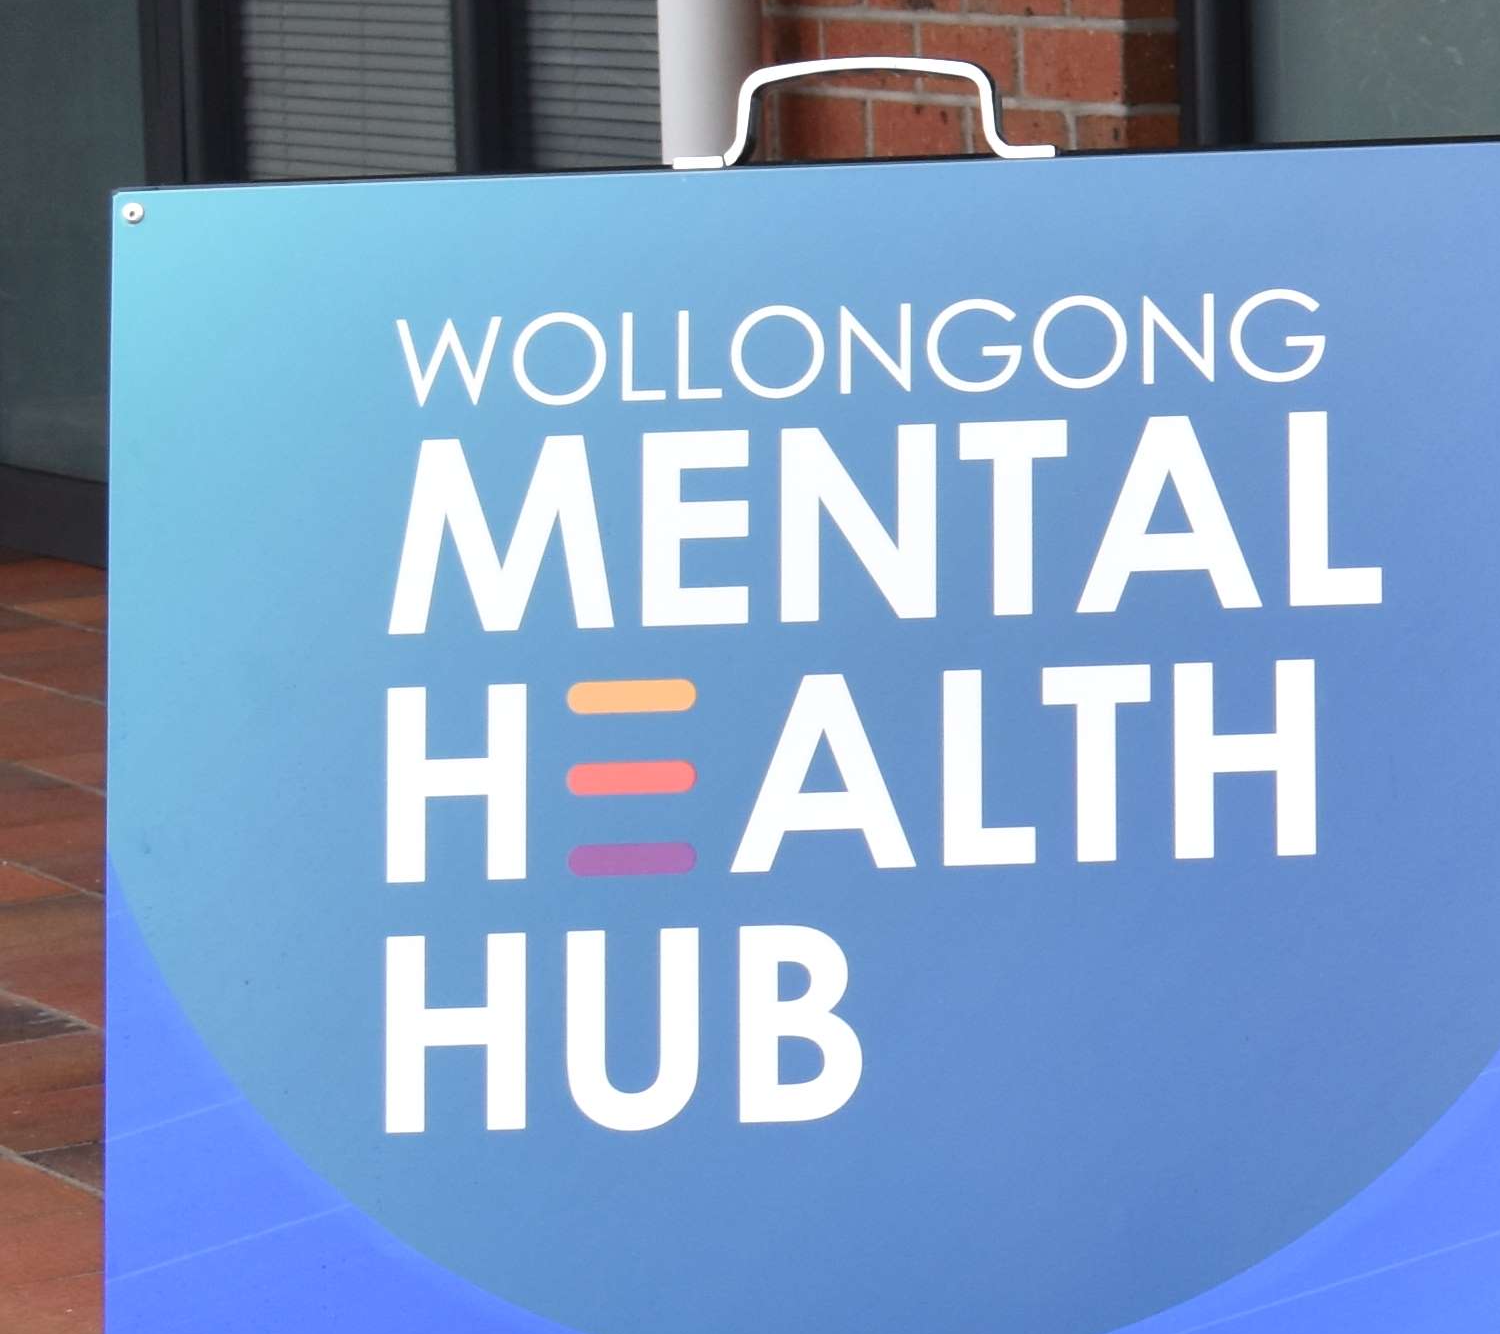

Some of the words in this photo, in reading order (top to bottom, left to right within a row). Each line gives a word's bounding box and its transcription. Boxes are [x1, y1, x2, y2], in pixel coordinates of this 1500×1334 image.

[396, 288, 1325, 407] WOLLONGONG
[388, 411, 1383, 635] MENTAL
[386, 659, 1316, 884] HEALTH
[385, 925, 863, 1134] HUB
